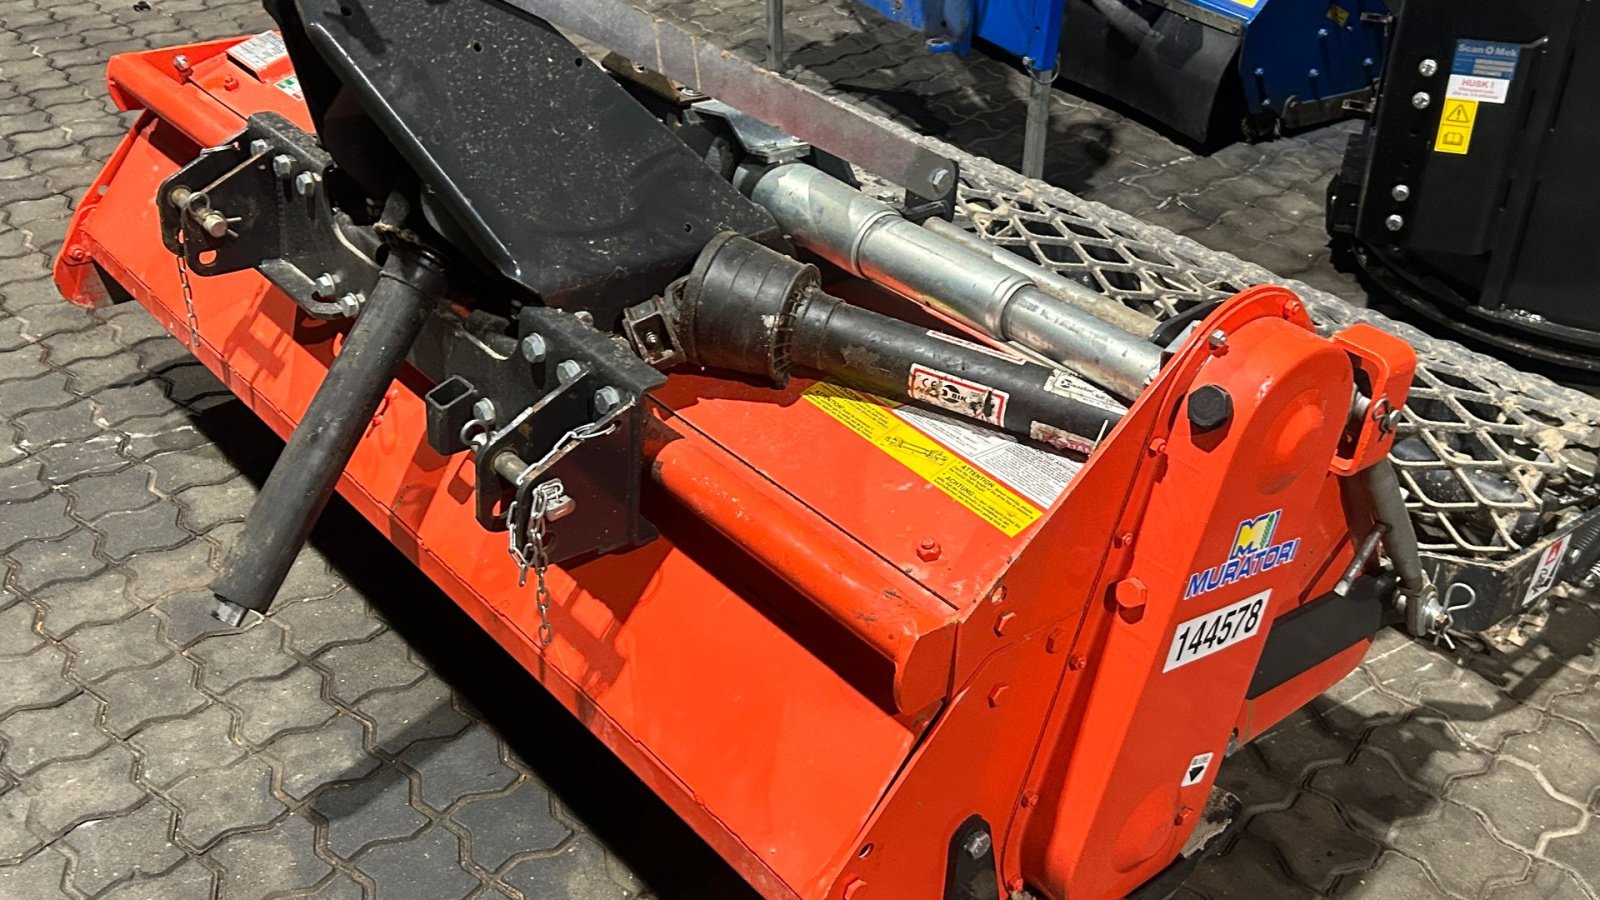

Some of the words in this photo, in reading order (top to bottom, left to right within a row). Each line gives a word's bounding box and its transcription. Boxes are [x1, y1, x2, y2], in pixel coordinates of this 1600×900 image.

[945, 476, 975, 496] ACHTUNG
[961, 464, 995, 488] ATTENTION
[1184, 538, 1301, 600] MURATORI
[1175, 598, 1263, 661] 144578
